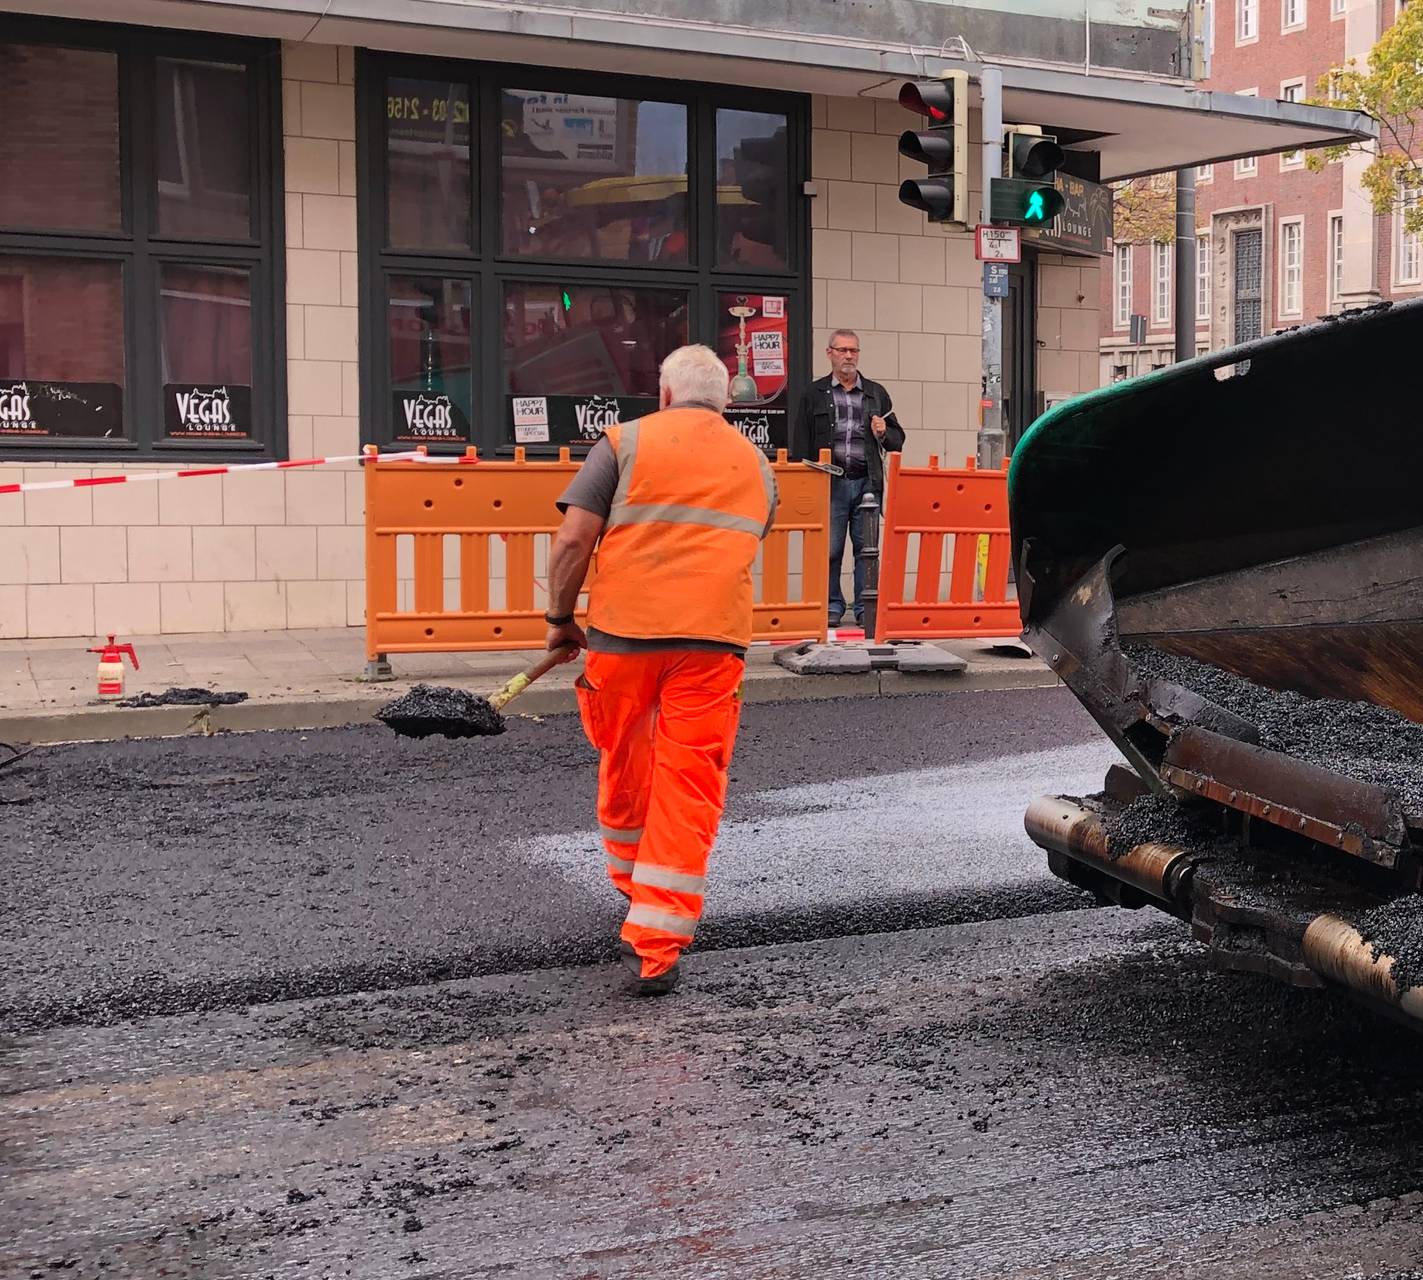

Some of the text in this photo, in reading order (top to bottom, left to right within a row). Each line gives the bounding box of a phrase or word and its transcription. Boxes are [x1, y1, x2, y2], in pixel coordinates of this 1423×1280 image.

[1062, 221, 1092, 238] LOUNGE
[753, 333, 780, 341] HAPPY
[754, 341, 780, 349] HOUR
[515, 399, 543, 407] HAPPY
[175, 393, 231, 424] VEGAS
[516, 407, 544, 416] HOUR
[403, 399, 452, 429] VEGAS
[186, 423, 236, 431] LOUNGE
[412, 428, 456, 436] LOUNGE
